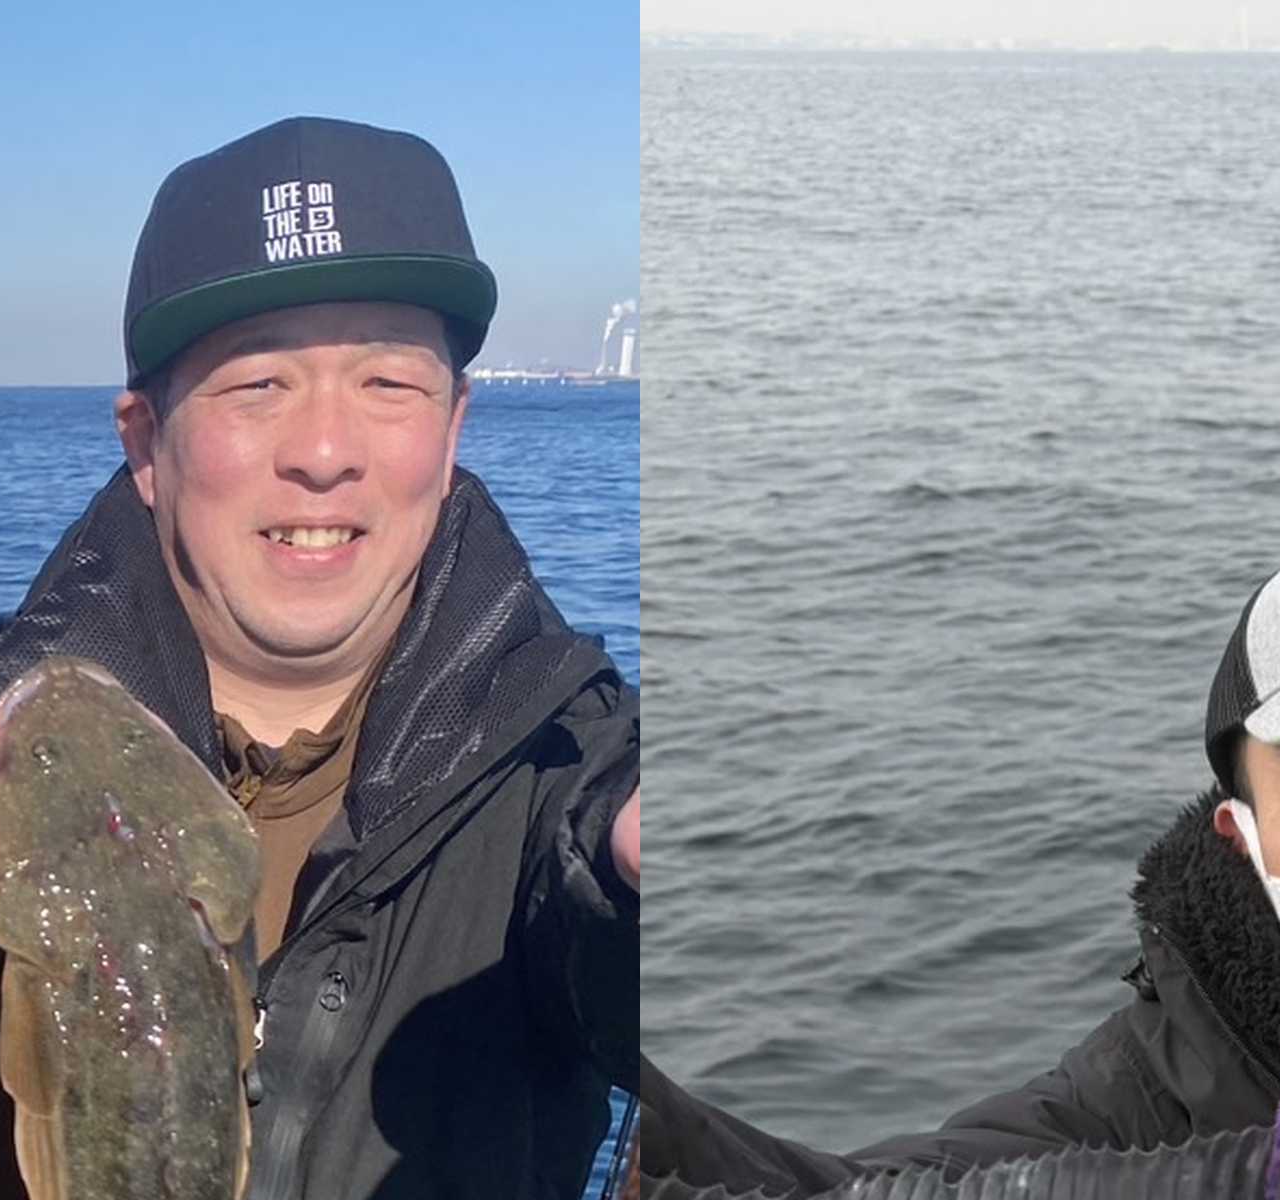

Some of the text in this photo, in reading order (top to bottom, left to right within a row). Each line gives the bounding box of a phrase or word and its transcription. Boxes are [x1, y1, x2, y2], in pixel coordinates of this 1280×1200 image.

[262, 181, 302, 214] LIFE
[263, 208, 302, 239] THE
[264, 231, 342, 262] WATER
